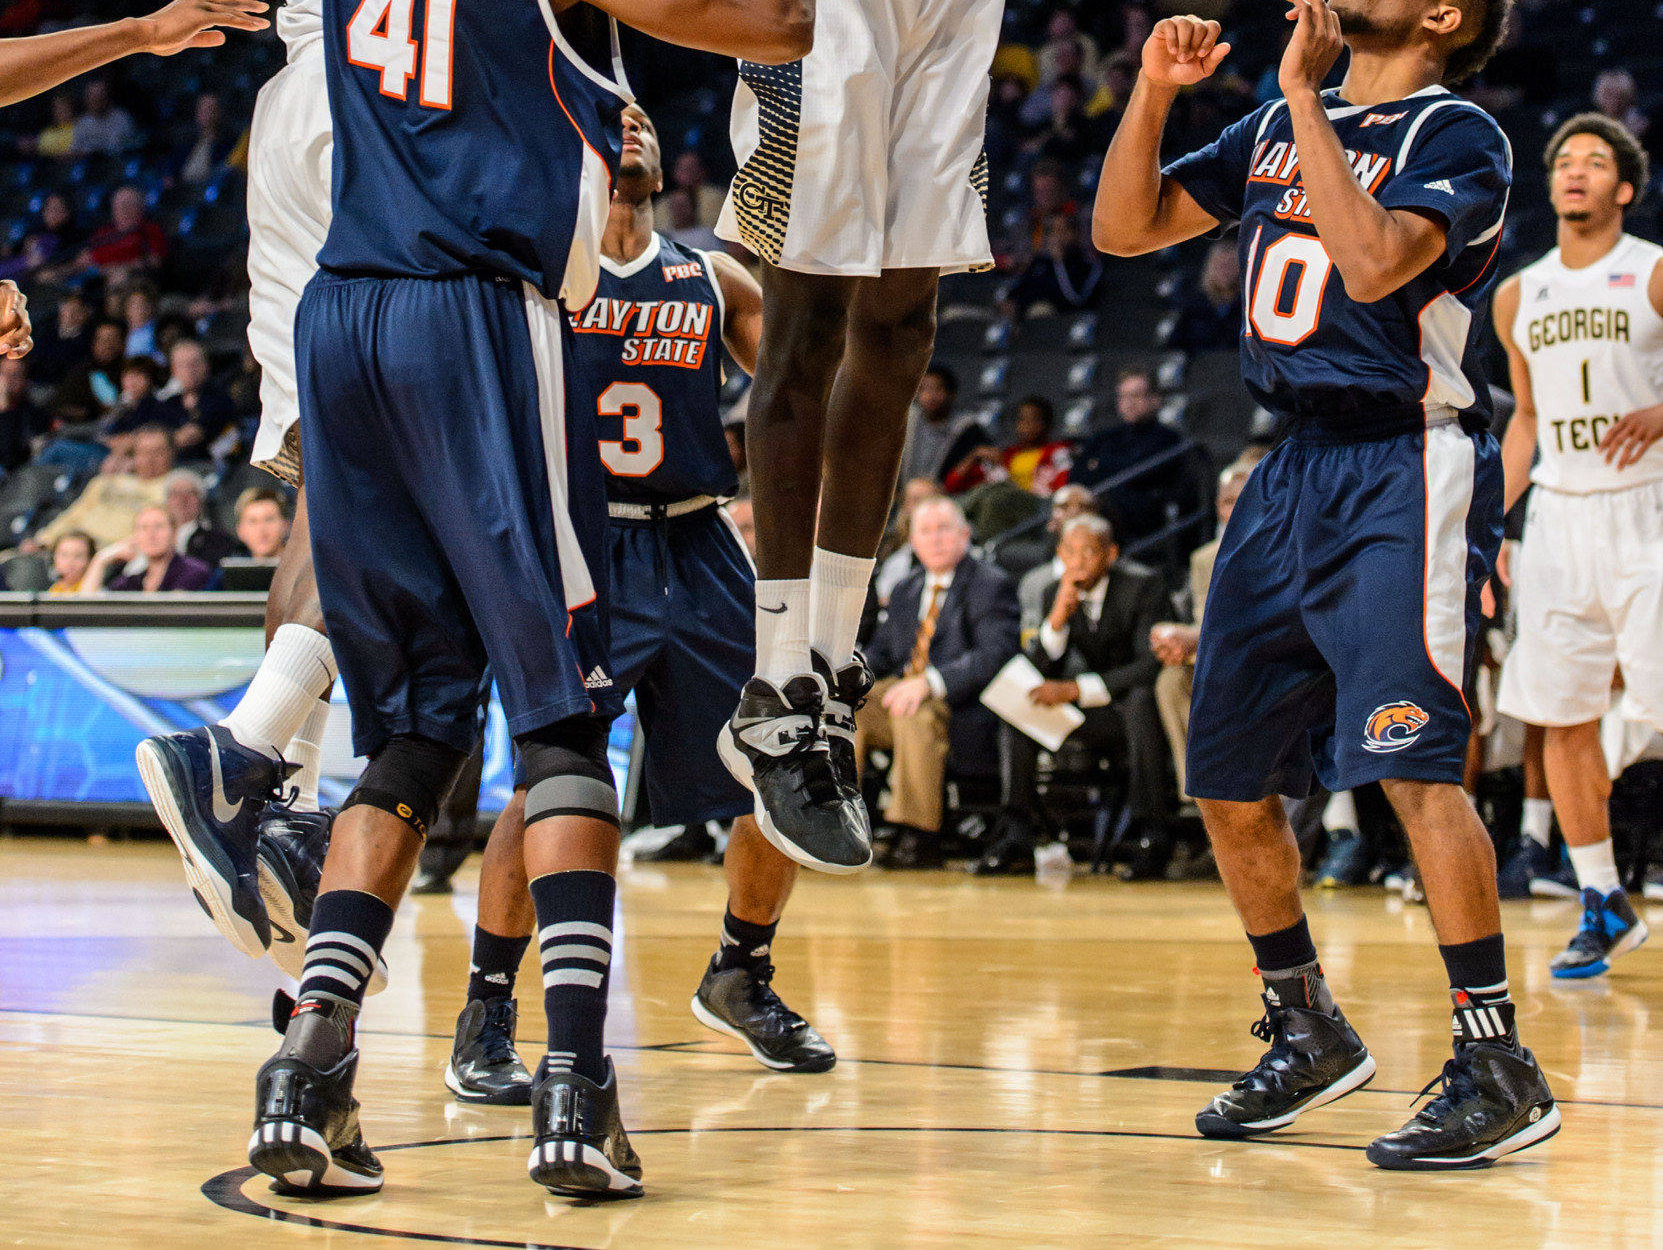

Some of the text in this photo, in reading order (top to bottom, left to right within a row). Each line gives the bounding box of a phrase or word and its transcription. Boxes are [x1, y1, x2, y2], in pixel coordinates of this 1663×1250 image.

[662, 262, 702, 283] PBC
[1528, 307, 1631, 353] GEORGIA
[622, 337, 706, 370] STATE
[1581, 358, 1591, 405] 1
[597, 381, 663, 478] 3
[1551, 413, 1622, 454] TEC
